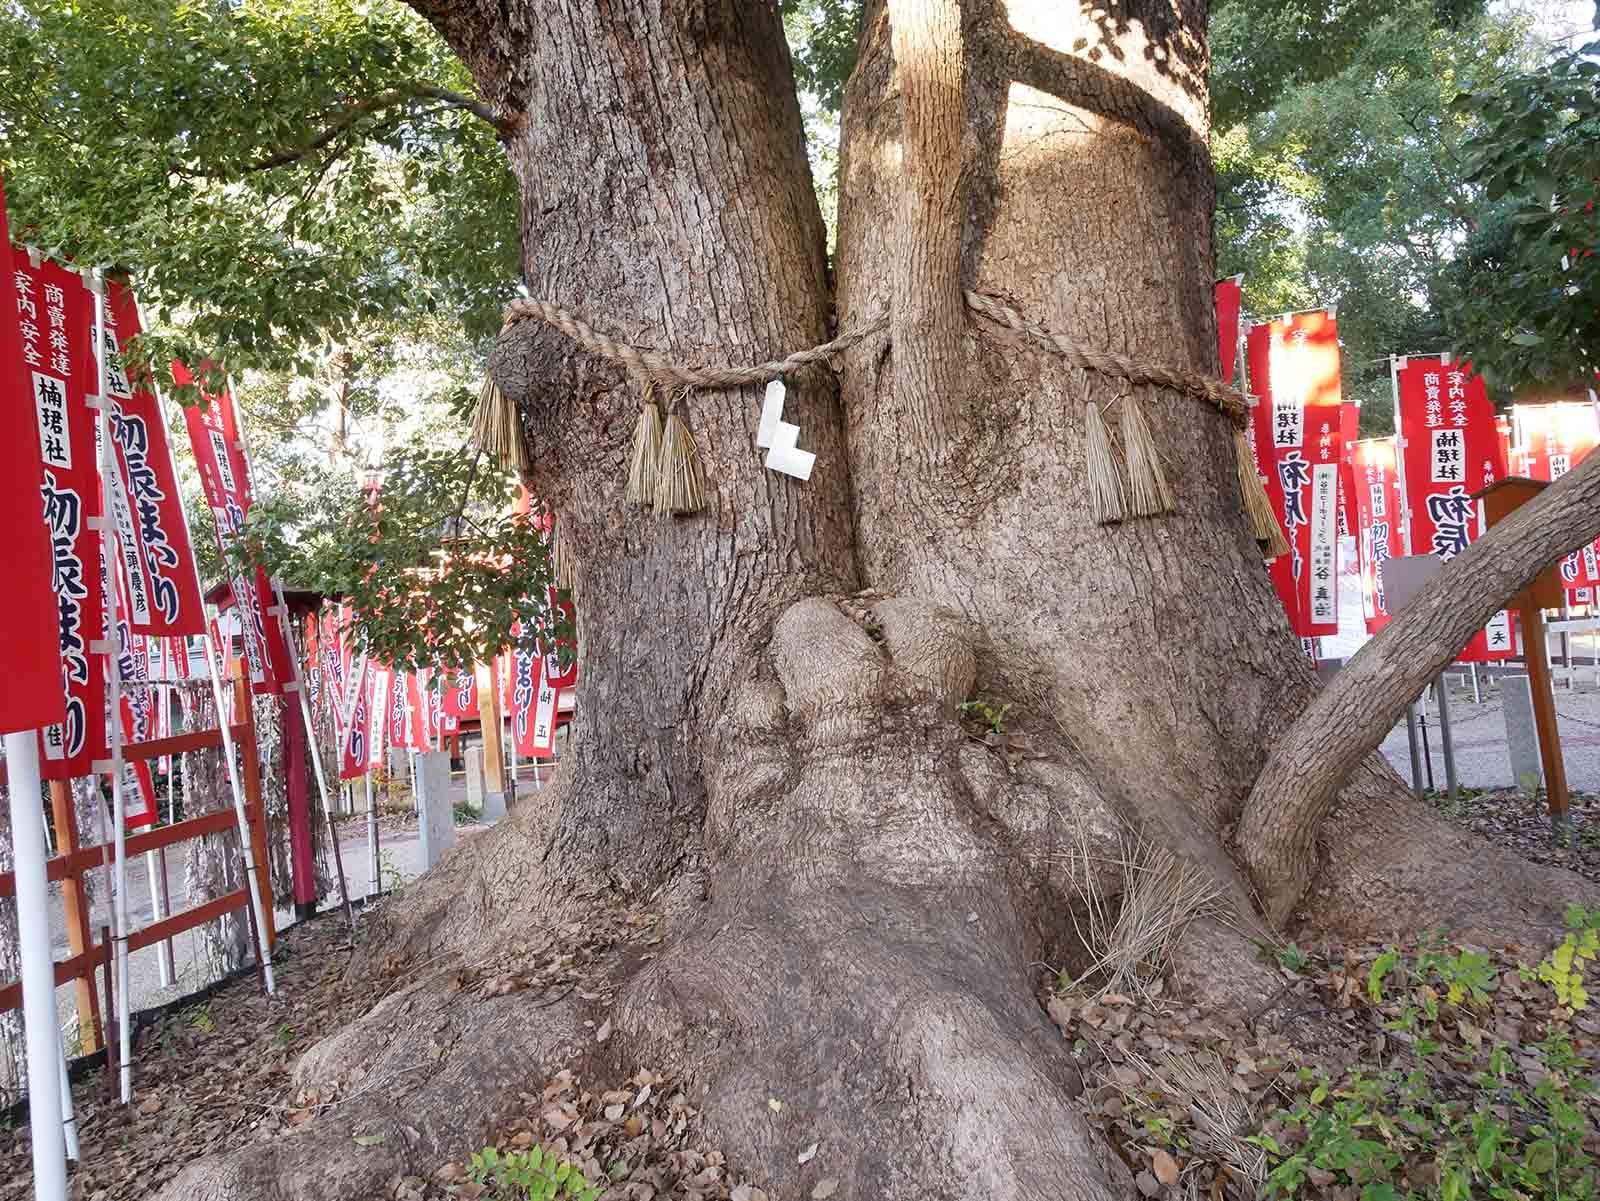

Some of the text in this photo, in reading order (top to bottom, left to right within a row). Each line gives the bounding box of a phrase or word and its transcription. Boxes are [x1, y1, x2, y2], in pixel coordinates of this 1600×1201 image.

[14, 270, 43, 367] 家内安全
[38, 376, 67, 462] 楠珺社
[109, 402, 180, 624] 初辰まいり
[41, 471, 88, 758] 初辰まいり
